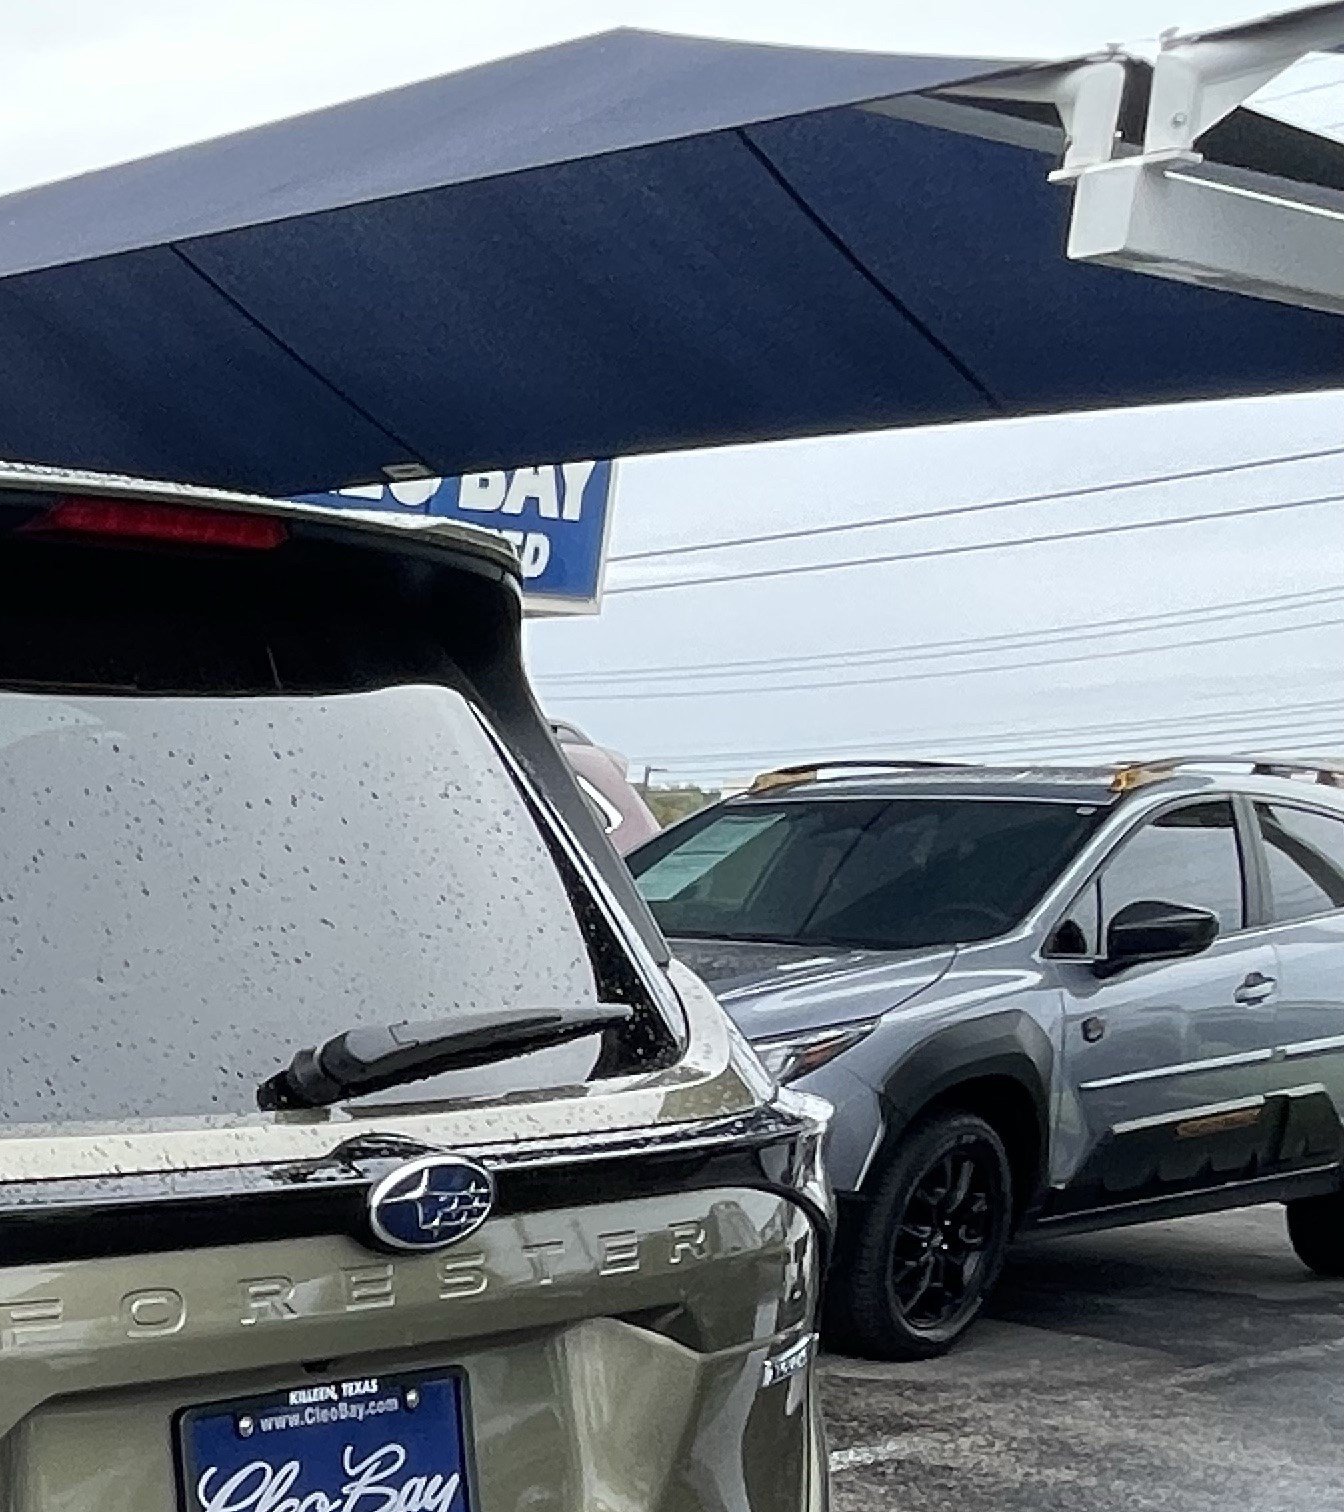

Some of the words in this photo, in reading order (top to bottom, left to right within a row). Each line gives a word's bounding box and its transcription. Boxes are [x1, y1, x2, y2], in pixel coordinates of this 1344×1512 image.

[459, 461, 596, 522] BAY
[342, 1379, 379, 1399] TEXAS
[260, 1397, 399, 1432] www.CleoBay.com
